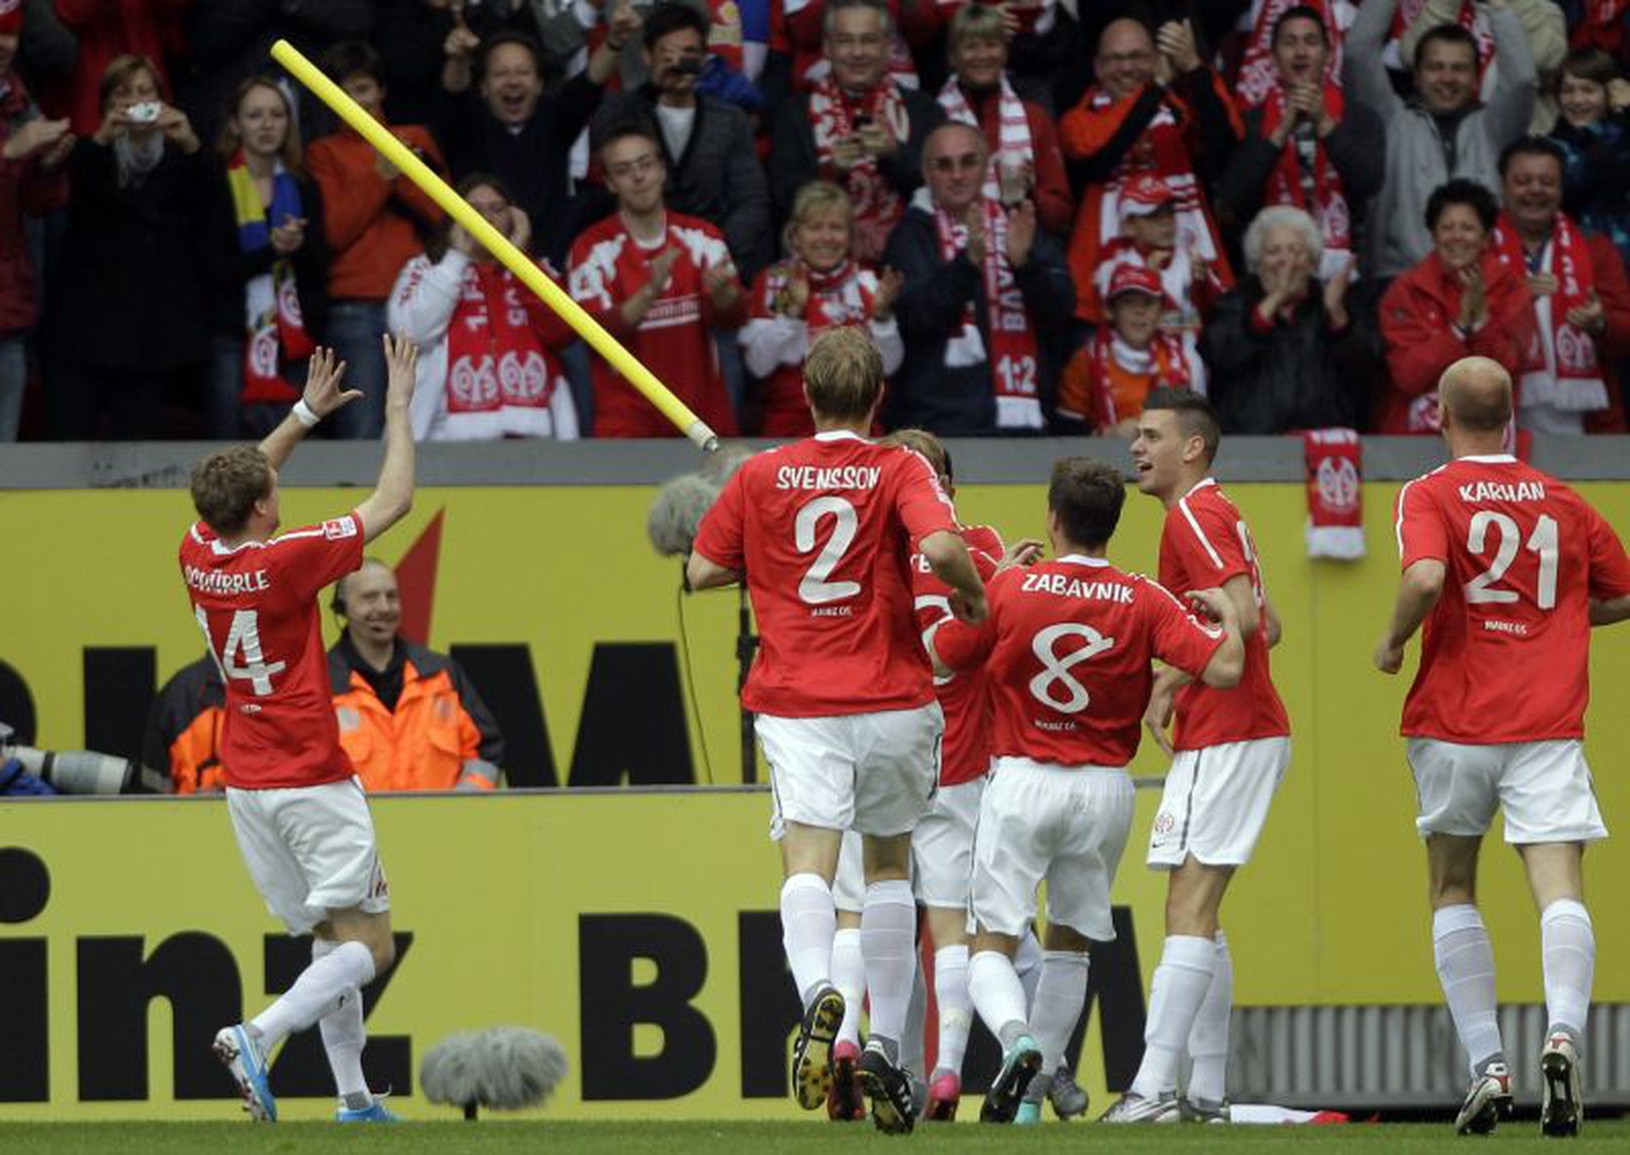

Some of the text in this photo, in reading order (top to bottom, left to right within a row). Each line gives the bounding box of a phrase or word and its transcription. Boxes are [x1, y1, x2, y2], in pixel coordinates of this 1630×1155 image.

[997, 354, 1037, 392] 1:2
[776, 465, 881, 489] SVENSSON
[1459, 481, 1545, 503] KARHAN
[795, 496, 861, 604] 2
[1465, 510, 1559, 609] 21
[1021, 573, 1135, 603] ZABAVNIK
[195, 603, 286, 696] 14
[1029, 623, 1115, 713] 8
